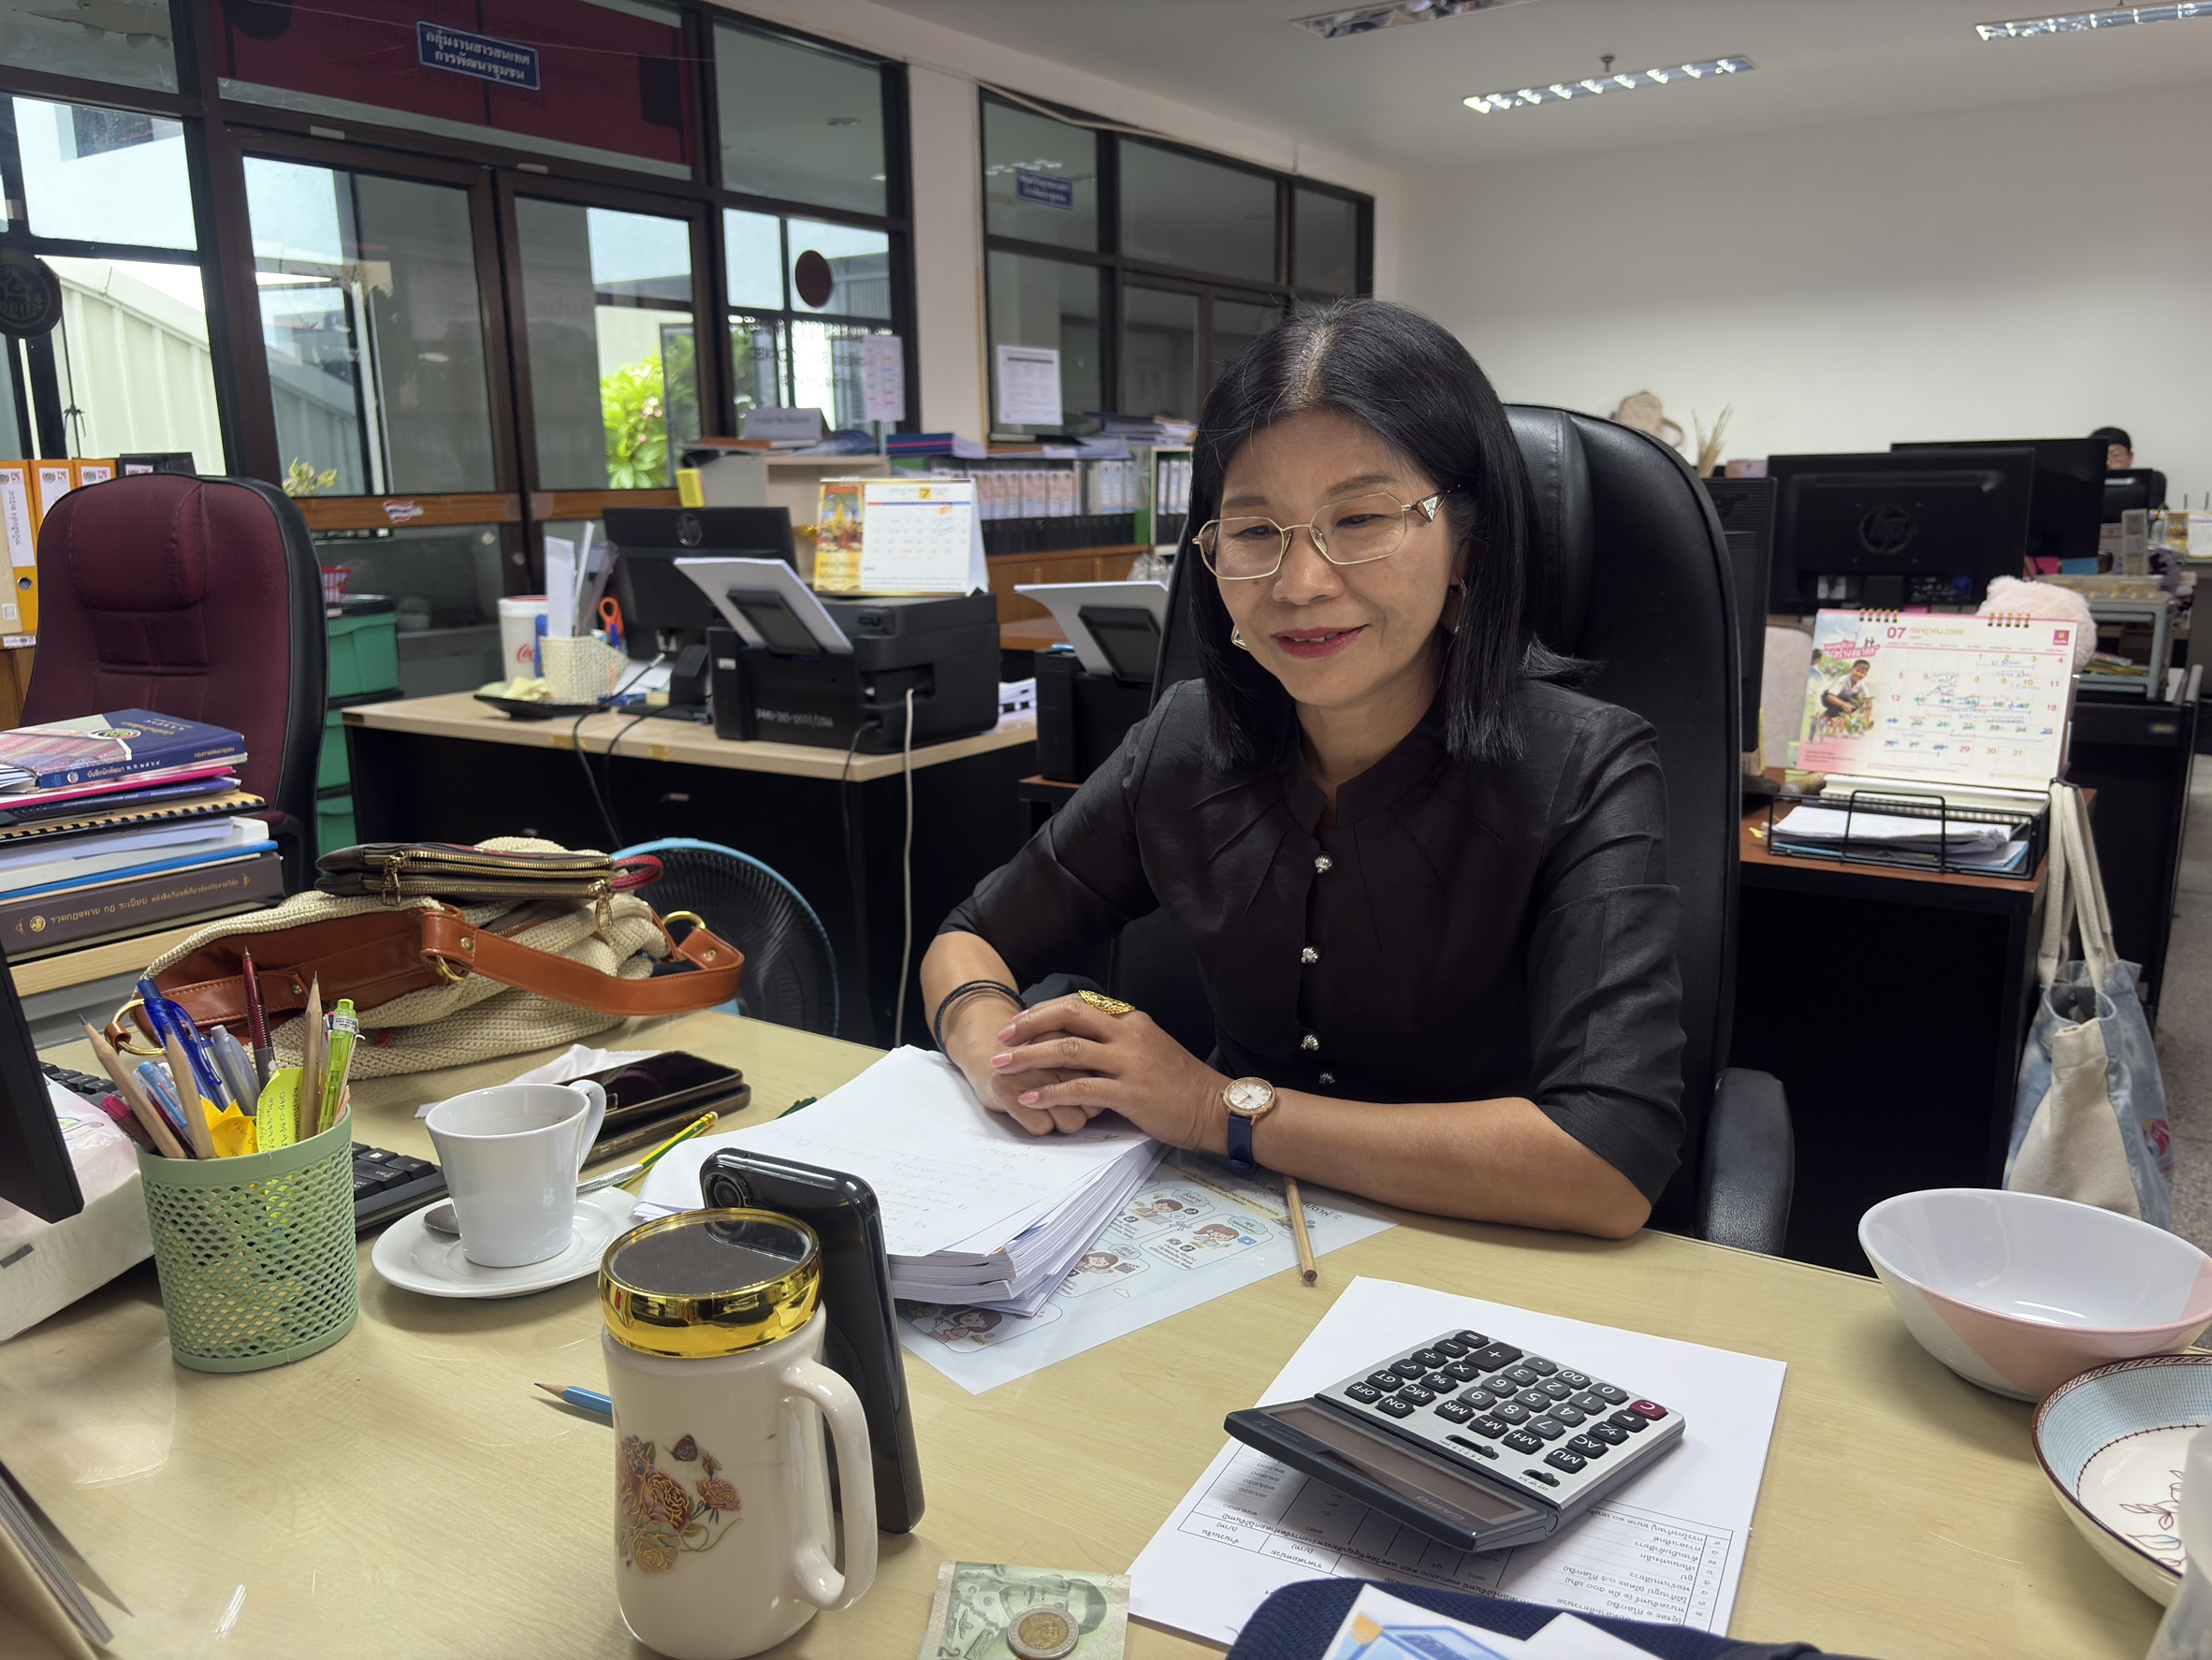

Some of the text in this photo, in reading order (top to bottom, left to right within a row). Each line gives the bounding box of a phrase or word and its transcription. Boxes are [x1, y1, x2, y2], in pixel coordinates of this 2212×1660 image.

[426, 30, 531, 66] กลุ่มงานสารสนเทศ
[435, 51, 525, 80] การพัฒนาชุมชน
[1886, 627, 1906, 639] 07
[50, 906, 101, 925] รวมกฎหมาย
[103, 903, 116, 914] กฎ
[118, 895, 148, 910] ระเบียบ
[1375, 1373, 1396, 1383] GT
[1514, 1369, 1529, 1377] 3
[1562, 1371, 1585, 1382] 00
[1492, 1378, 1507, 1388] 6
[1546, 1381, 1563, 1391] 2
[1351, 1384, 1375, 1396] OFF
[1404, 1386, 1430, 1398] MC
[1471, 1391, 1487, 1400] 9
[1601, 1386, 1616, 1394] 0
[1525, 1392, 1541, 1402] 5
[1582, 1396, 1593, 1405] 1
[1385, 1398, 1406, 1409] ON
[1444, 1402, 1468, 1416] MR
[1504, 1404, 1520, 1414] 8
[1639, 1402, 1656, 1410] C
[1559, 1406, 1575, 1416] 4
[1536, 1420, 1553, 1430] 7
[1512, 1432, 1537, 1446] M+
[1574, 1435, 1602, 1448] AC
[1552, 1450, 1581, 1464] MU
[1215, 1521, 1237, 1532] (บาท)
[1626, 1518, 1648, 1529] ขนาด
[1201, 1527, 1239, 1545] จำนวนเงิน
[1651, 1523, 1703, 1543] กรรไกรก้ามปู
[1290, 1543, 1313, 1554] (บาท)
[1634, 1540, 1697, 1563] ด้ายเย็บผ้าสีขาว
[1639, 1551, 1695, 1573] เทียนแท่งเล็ก
[1562, 1564, 1598, 1580] กิโลกรัม)
[1680, 1572, 1693, 1582] ธูป
[1564, 1576, 1583, 1588] เส้น)
[1617, 1578, 1645, 1592] (มัดละ
[1607, 1588, 1621, 1597] มัด
[1646, 1585, 1687, 1603] ไม้ก้านธูป
[1606, 1598, 1644, 1616] กิโลกรัม)
[1634, 1594, 1684, 1614] หนวดจันทร์
[1655, 1610, 1681, 1624] (ถุงละ
